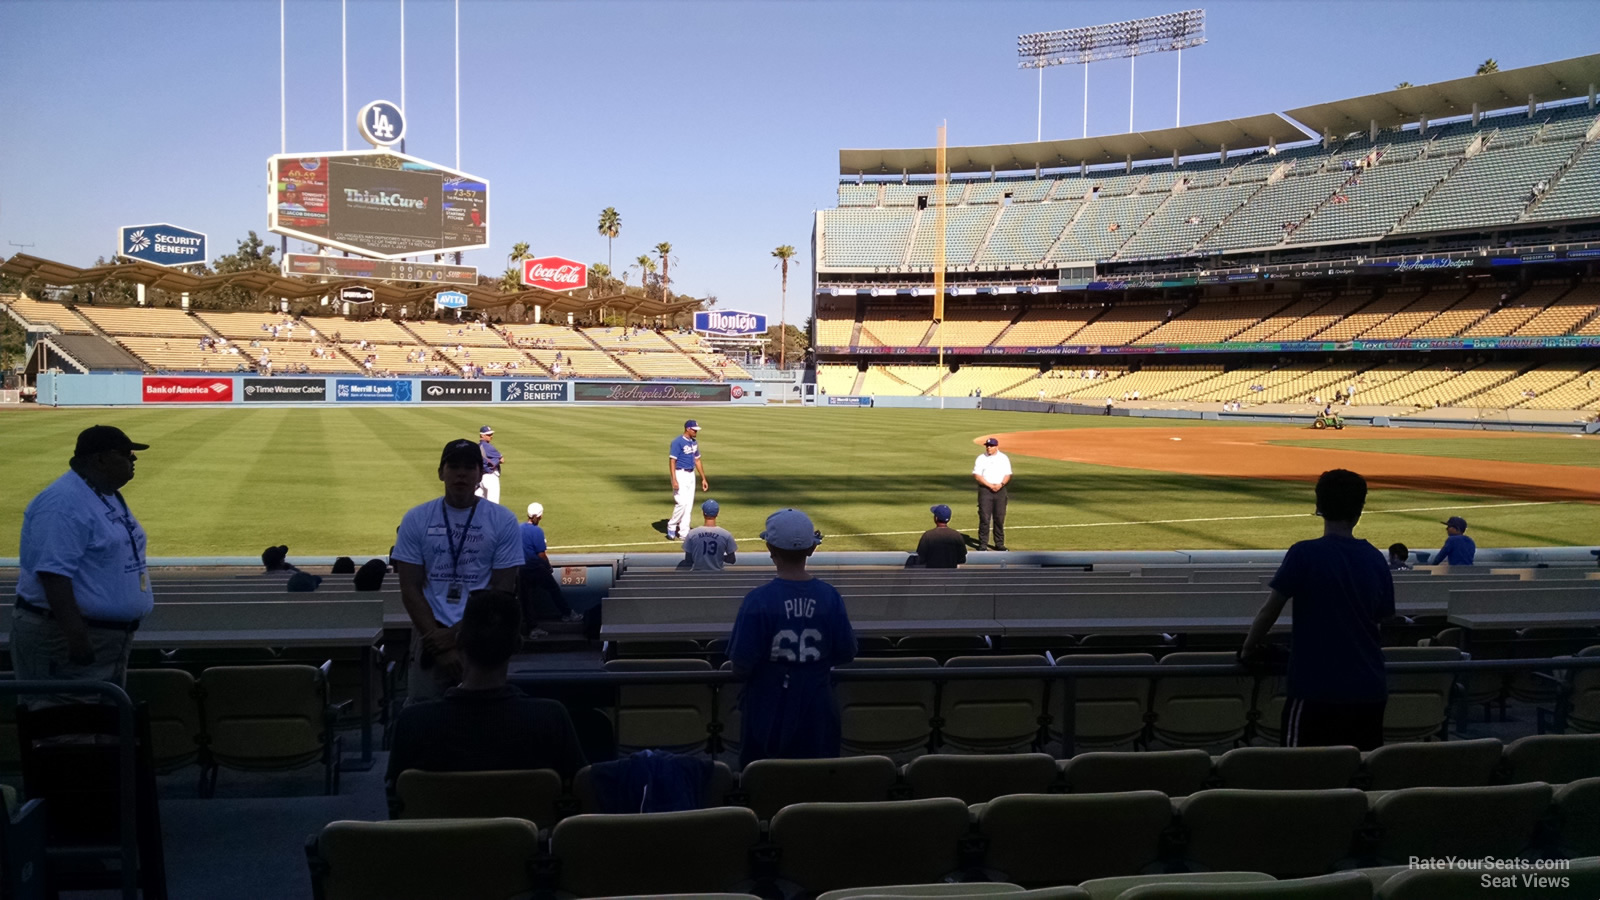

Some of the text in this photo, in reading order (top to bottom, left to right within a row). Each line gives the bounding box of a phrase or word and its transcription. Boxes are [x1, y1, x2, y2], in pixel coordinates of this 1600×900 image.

[372, 106, 394, 138] LA
[288, 170, 316, 180] 60-69
[453, 188, 476, 198] 73-57
[154, 234, 201, 246] SECURITY
[1440, 258, 1474, 268] Dodgers
[708, 312, 757, 332] Montejo
[1384, 340, 1413, 348] CURE
[1545, 338, 1555, 346] in
[1559, 338, 1577, 346] the
[167, 385, 176, 393] of
[374, 386, 392, 394] Lynch
[524, 382, 563, 391] SECURITY
[606, 385, 700, 401] Los Angeles Dodgers
[702, 541, 717, 556] 13
[784, 598, 816, 619] PUIG
[770, 628, 822, 662] 66
